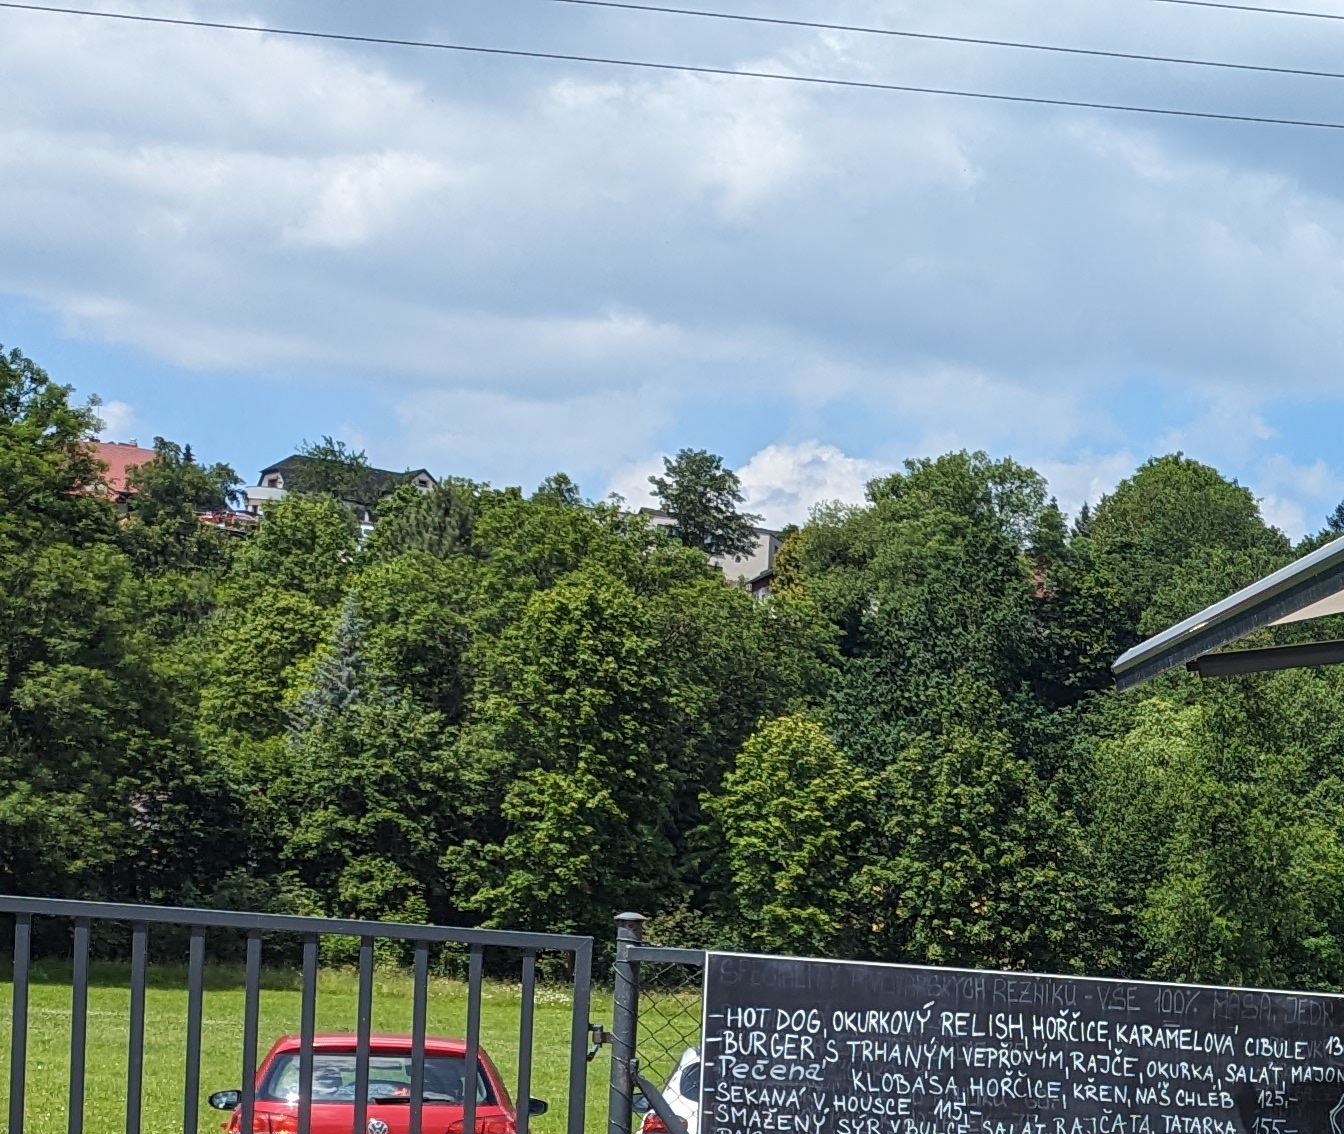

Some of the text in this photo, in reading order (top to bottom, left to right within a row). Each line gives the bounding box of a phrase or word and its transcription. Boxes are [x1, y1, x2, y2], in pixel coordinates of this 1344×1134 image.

[727, 1008, 771, 1028] HOT
[832, 1000, 935, 1035] OKURKOVÝ
[1116, 1022, 1240, 1057] KARAMELOVÁ
[1244, 1038, 1309, 1060] CIBULE
[723, 1030, 815, 1060] BURGER
[847, 1037, 954, 1070] TRHANÝM
[715, 1081, 807, 1111] SEKANÁ
[833, 1095, 912, 1116] HOUSCE
[715, 1104, 830, 1134] SMAŽENÝ
